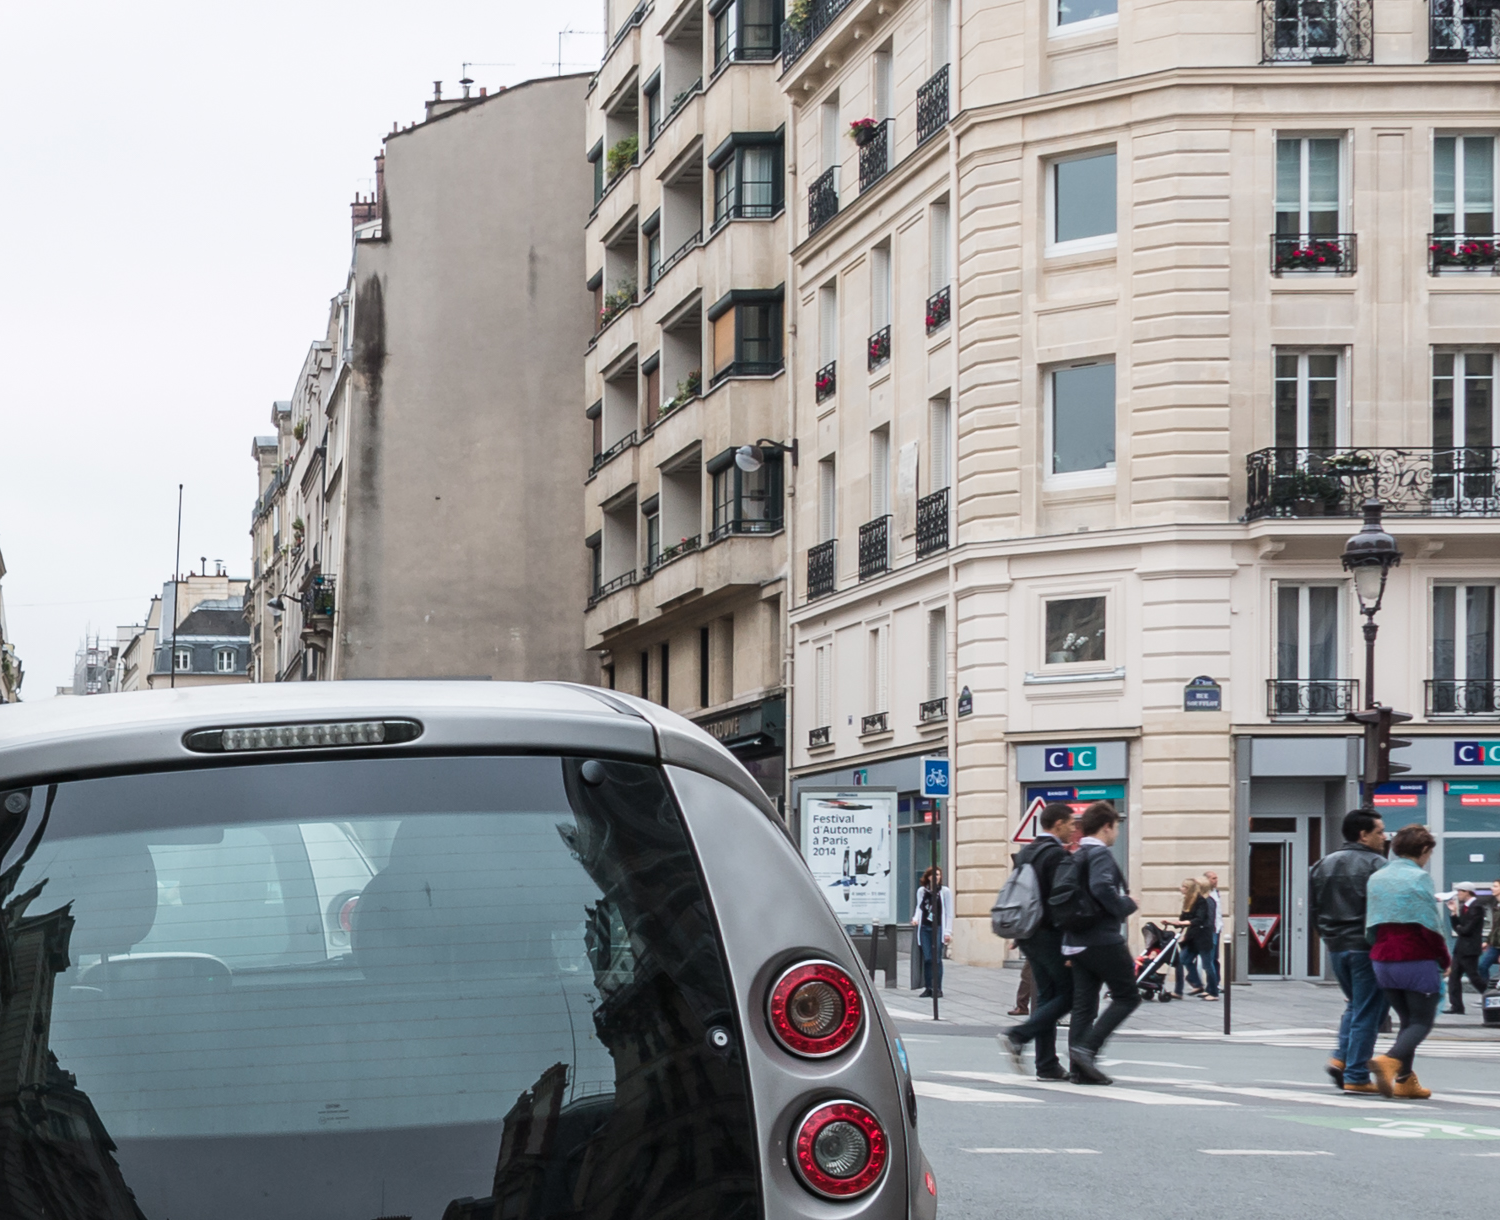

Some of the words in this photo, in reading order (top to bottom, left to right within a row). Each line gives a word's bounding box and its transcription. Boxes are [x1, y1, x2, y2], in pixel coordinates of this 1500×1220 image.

[1049, 750, 1093, 769] CIC
[813, 814, 855, 824] Festival
[813, 825, 873, 835] d'Automne
[813, 836, 819, 845] à
[822, 836, 849, 845] Paris
[813, 847, 837, 856] 2014
